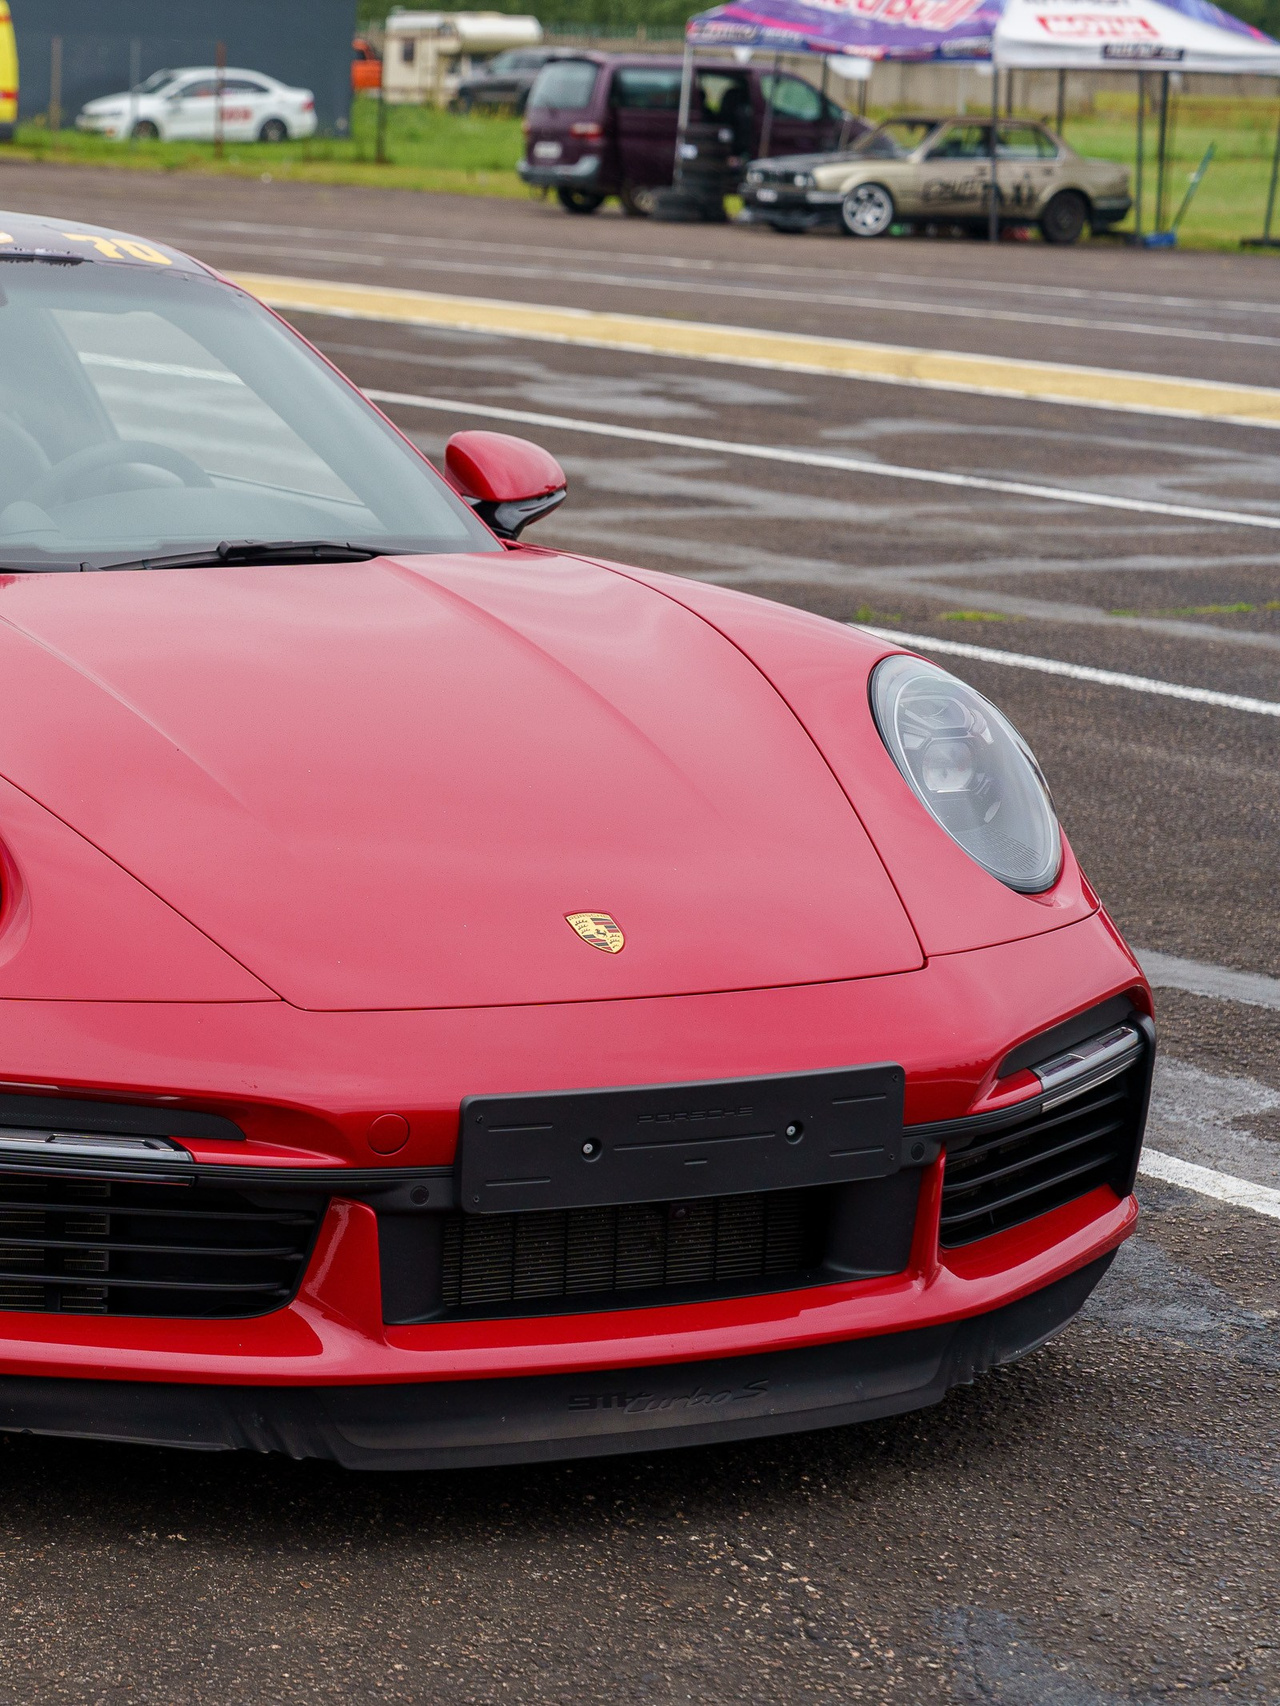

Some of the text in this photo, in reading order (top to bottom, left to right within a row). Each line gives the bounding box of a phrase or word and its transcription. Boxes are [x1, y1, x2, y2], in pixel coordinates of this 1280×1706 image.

[61, 232, 173, 265] 70
[636, 1106, 754, 1125] PORSCHE
[623, 1387, 733, 1415] turbo
